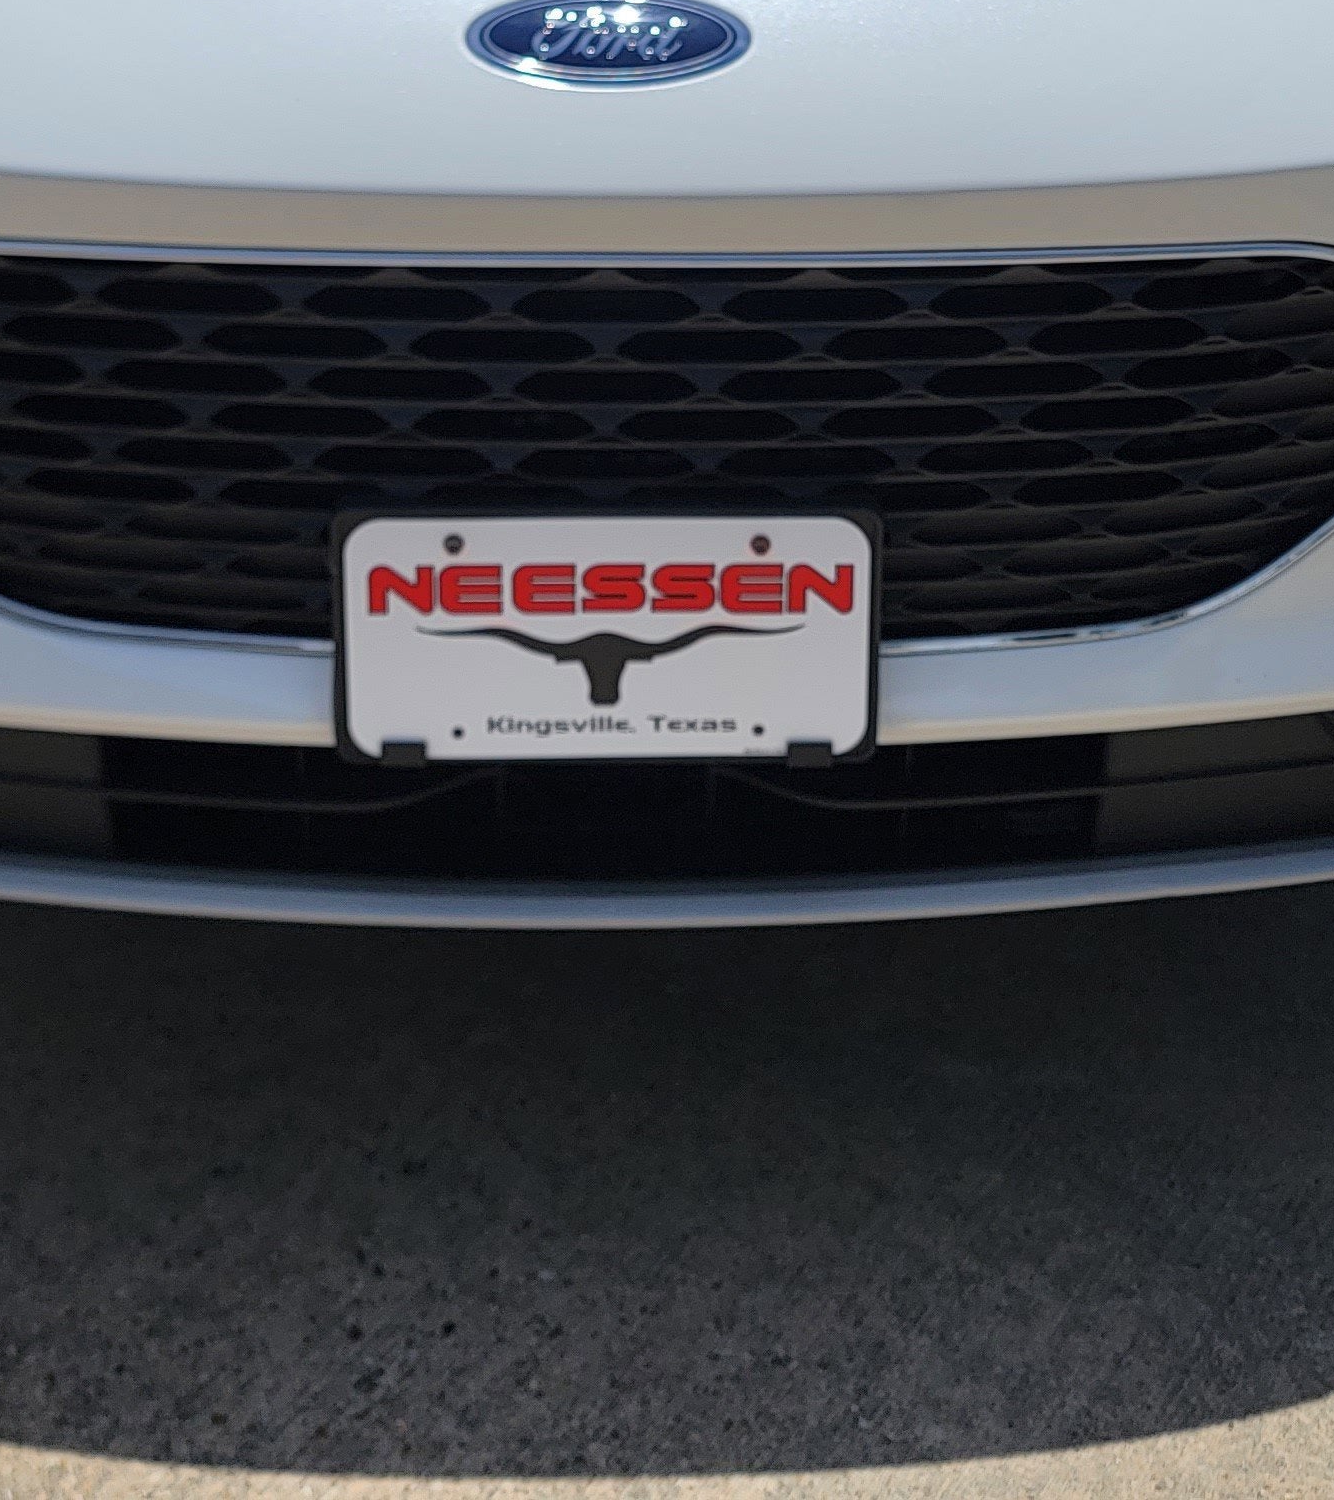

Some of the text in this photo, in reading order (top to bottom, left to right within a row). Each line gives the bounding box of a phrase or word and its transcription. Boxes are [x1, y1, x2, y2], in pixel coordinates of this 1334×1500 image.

[531, 8, 688, 60] Ford
[368, 564, 854, 615] NEESSEN
[487, 715, 738, 736] Kingsville, Texas
